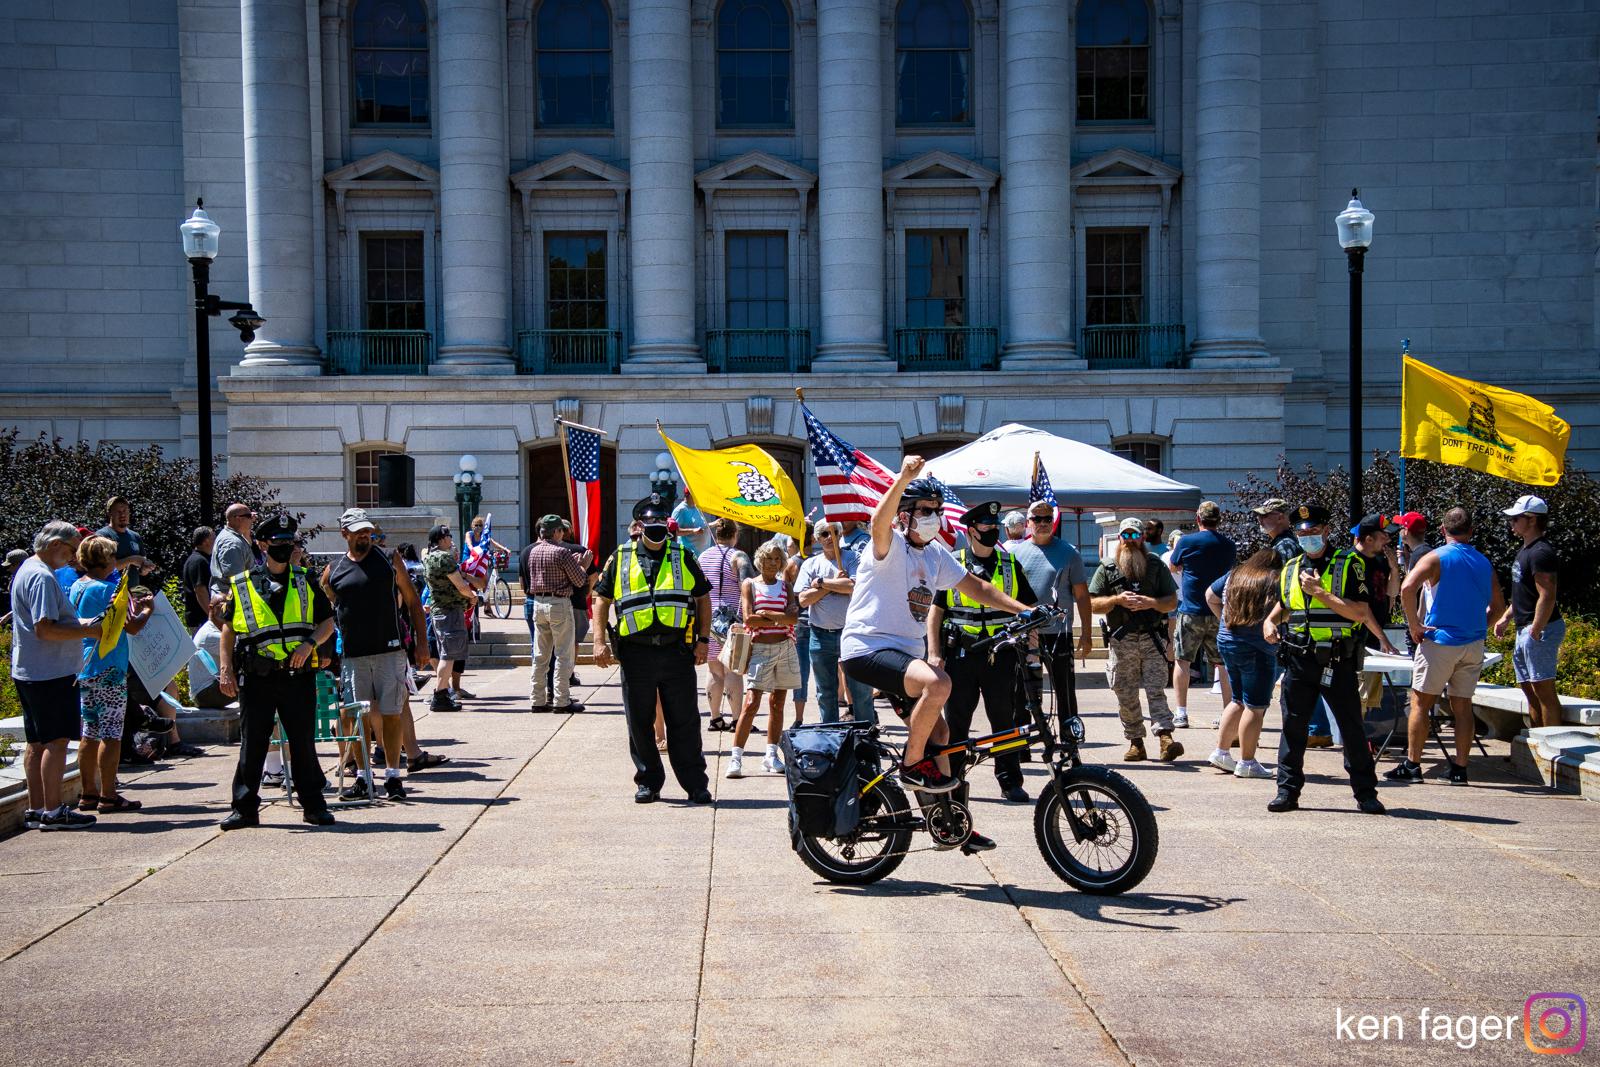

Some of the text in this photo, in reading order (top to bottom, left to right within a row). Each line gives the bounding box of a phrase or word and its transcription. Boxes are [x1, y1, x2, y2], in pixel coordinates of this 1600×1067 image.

[1442, 437, 1464, 449] DONT
[1467, 441, 1494, 456] TREAD
[1503, 453, 1516, 464] ME
[783, 515, 795, 527] ON
